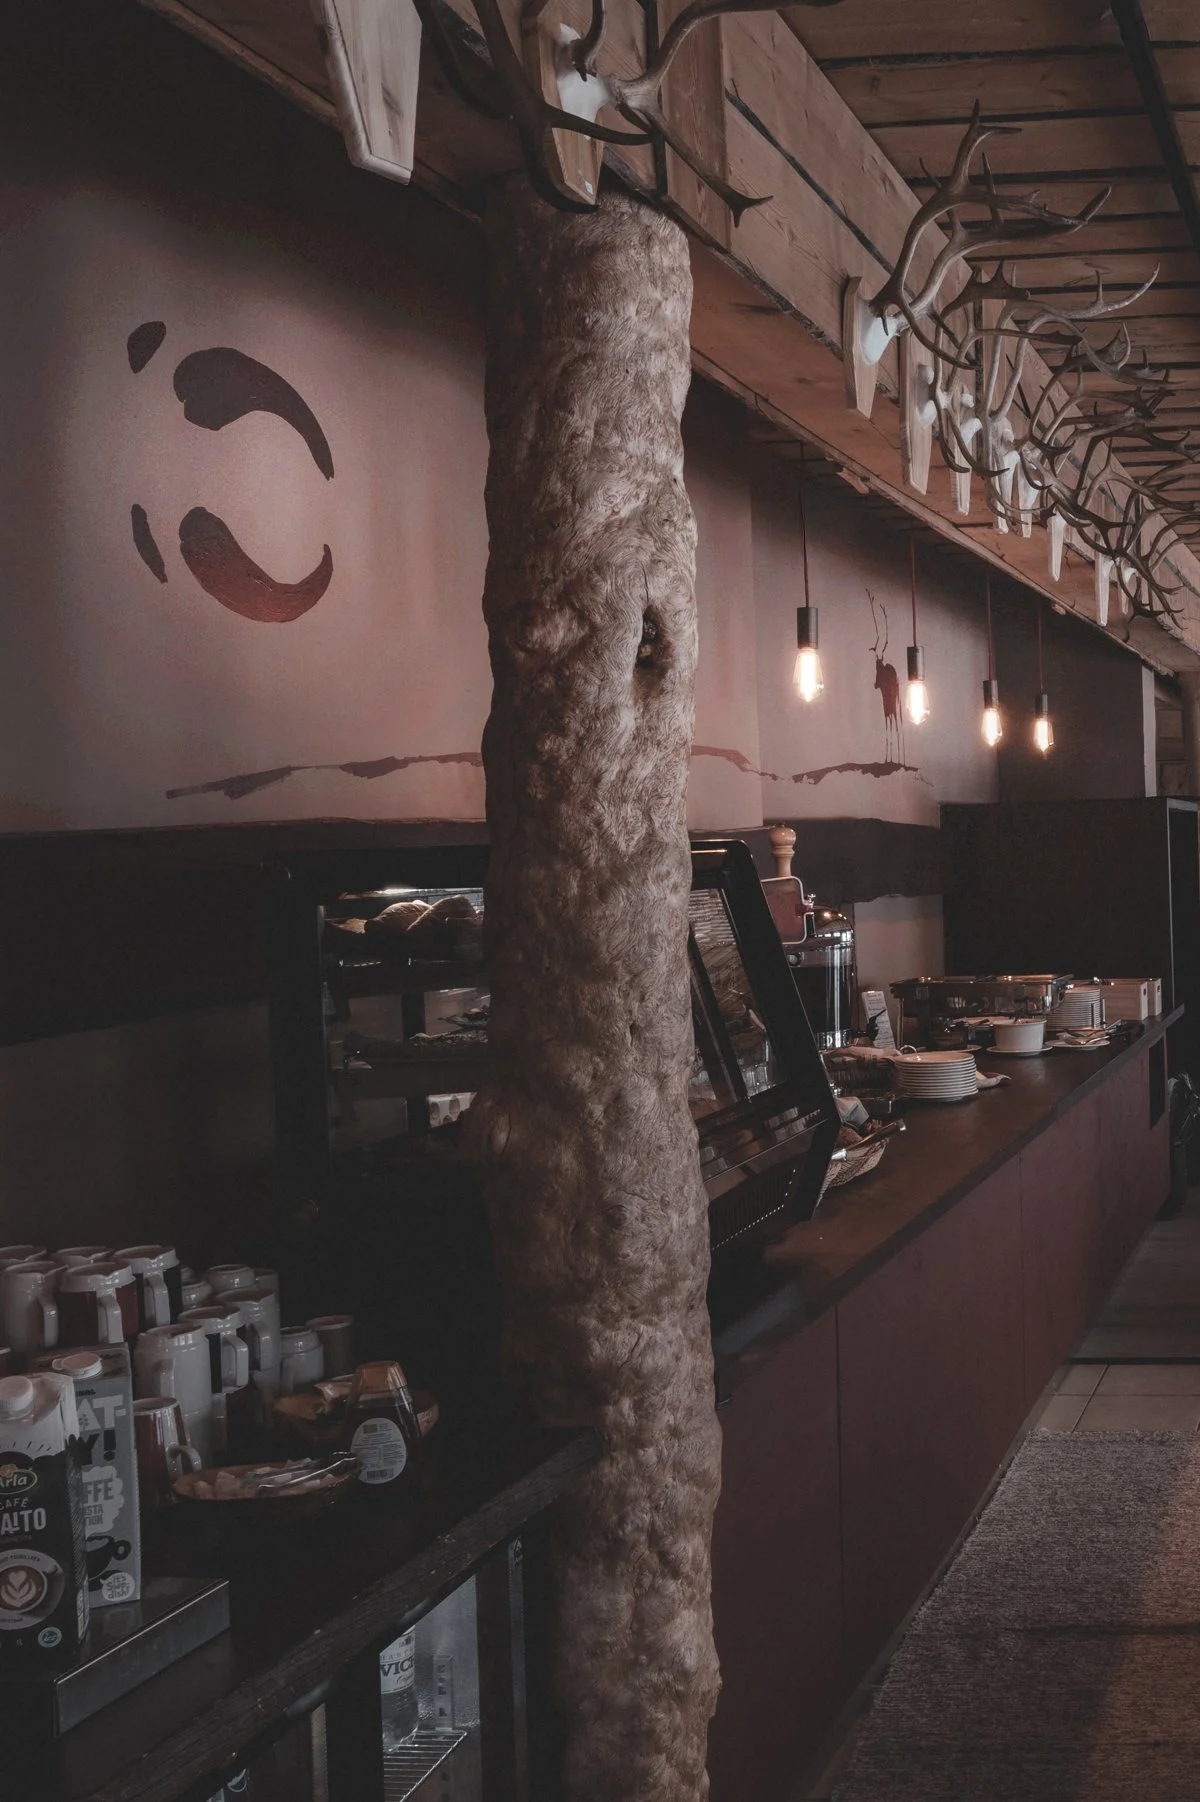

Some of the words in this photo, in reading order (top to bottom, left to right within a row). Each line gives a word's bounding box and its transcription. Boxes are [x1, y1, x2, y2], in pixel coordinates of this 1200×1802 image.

[76, 1394, 127, 1432] AT-
[79, 1430, 117, 1465] Y!
[83, 1478, 115, 1503] FFE
[0, 1507, 47, 1536] AITO
